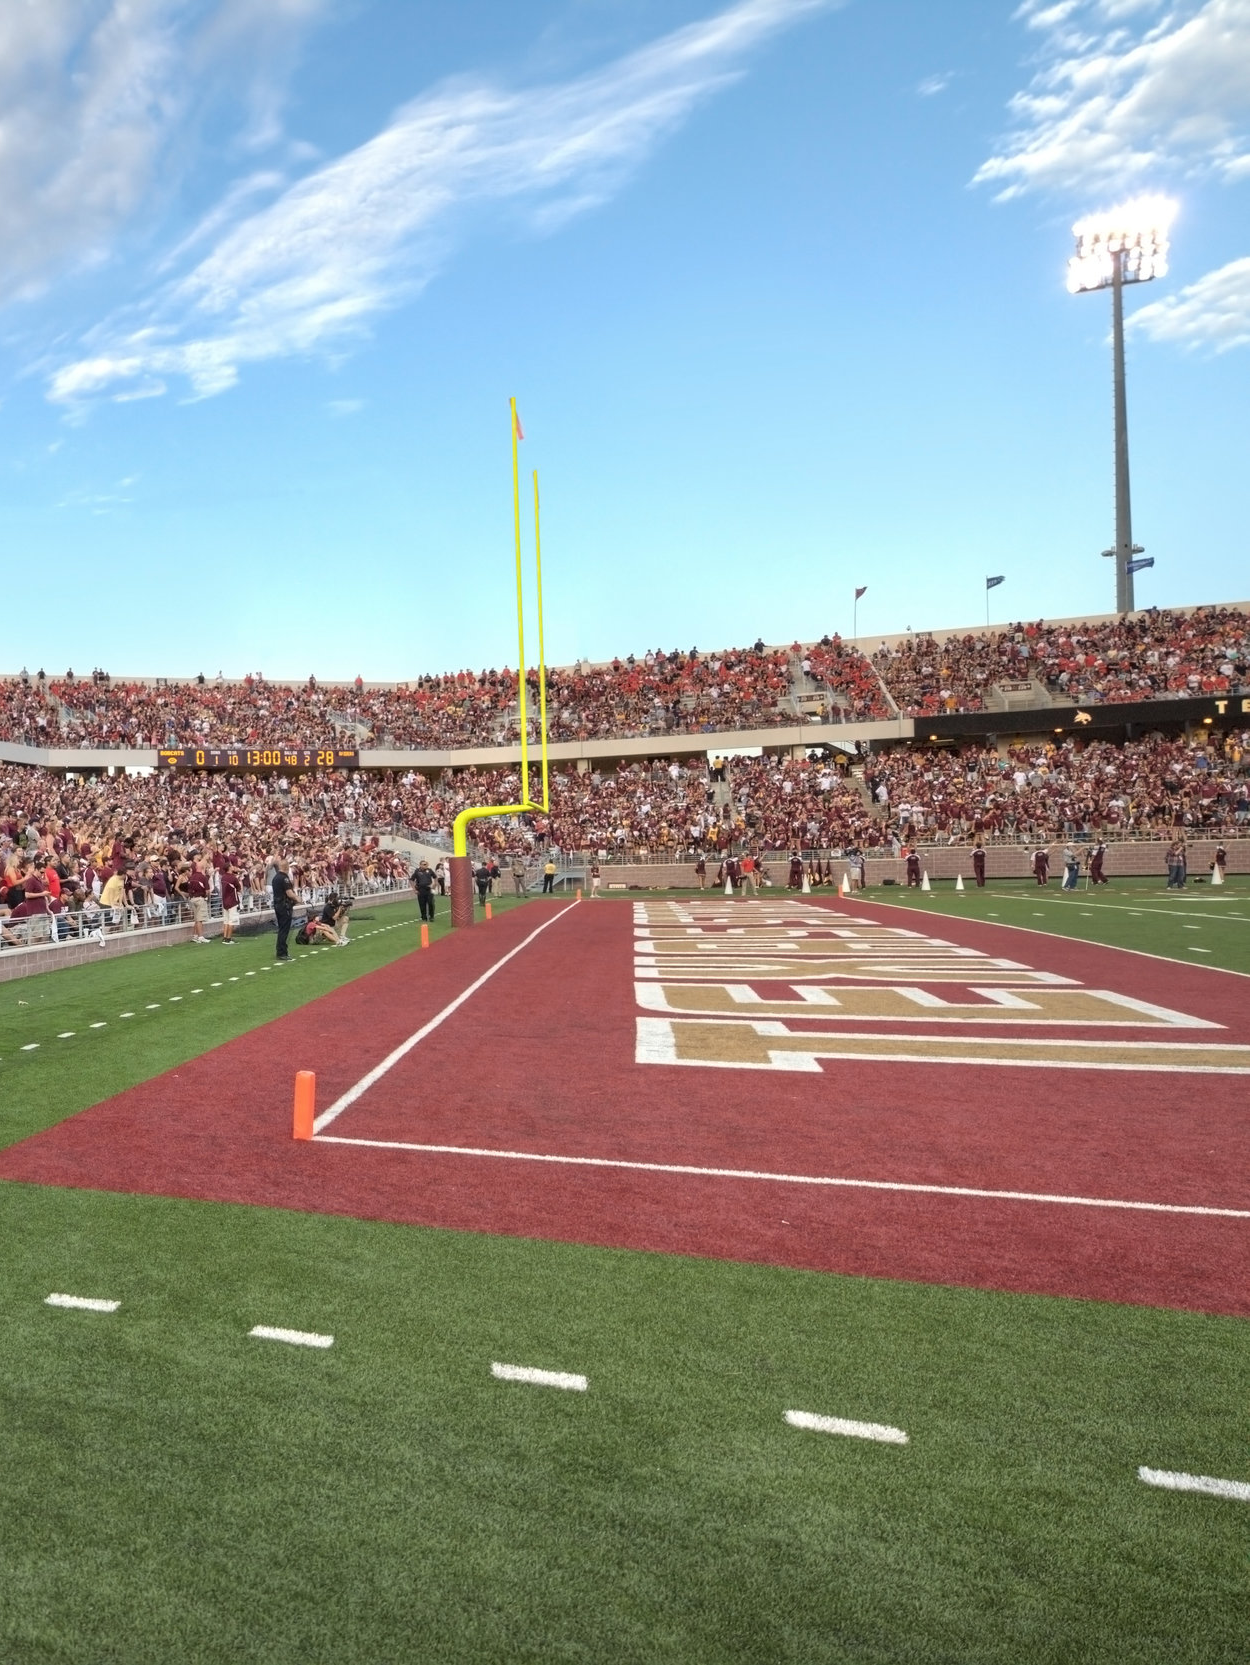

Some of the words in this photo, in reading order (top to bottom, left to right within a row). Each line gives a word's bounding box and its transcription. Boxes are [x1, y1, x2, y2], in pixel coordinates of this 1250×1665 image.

[196, 750, 205, 765] 0
[229, 755, 239, 766] 10
[247, 750, 281, 766] 13:00
[284, 755, 298, 766] 48
[304, 755, 311, 766] 2
[317, 750, 335, 766] 28
[634, 927, 1250, 1072] TEXAS
